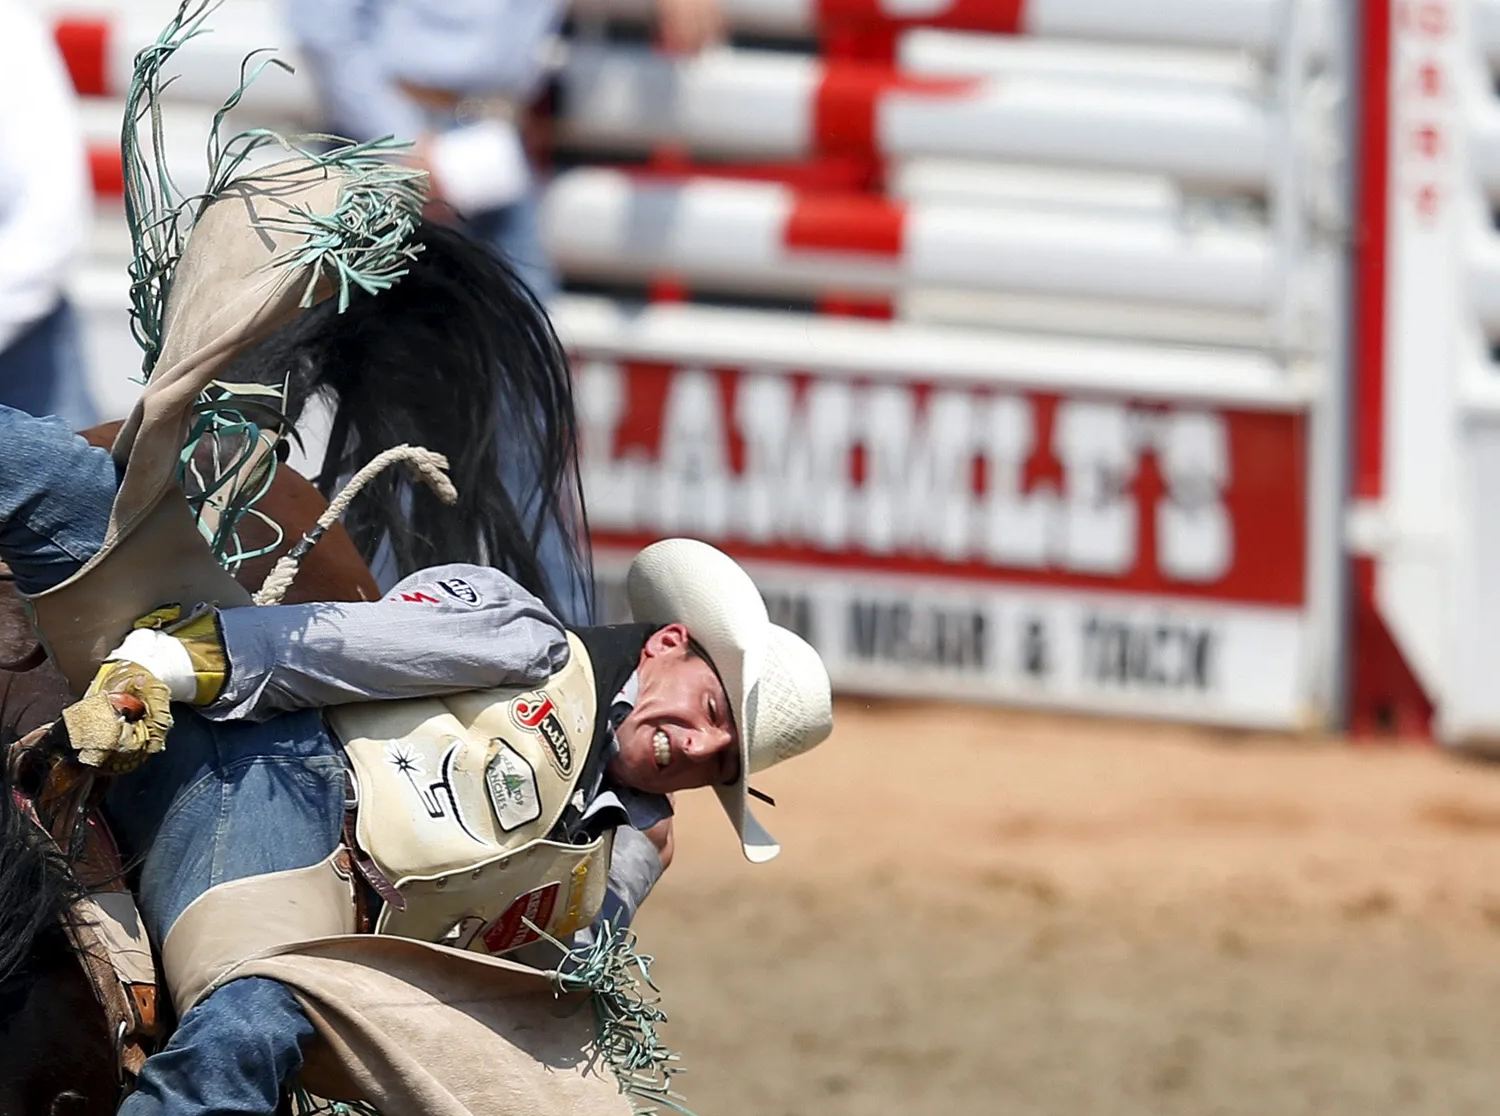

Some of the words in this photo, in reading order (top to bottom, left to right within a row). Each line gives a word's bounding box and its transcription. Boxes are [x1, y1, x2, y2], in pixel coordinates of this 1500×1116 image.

[850, 600, 989, 671] WEAR
[1019, 618, 1046, 676] &
[516, 698, 570, 769] Justin
[484, 765, 509, 811] ANCHES
